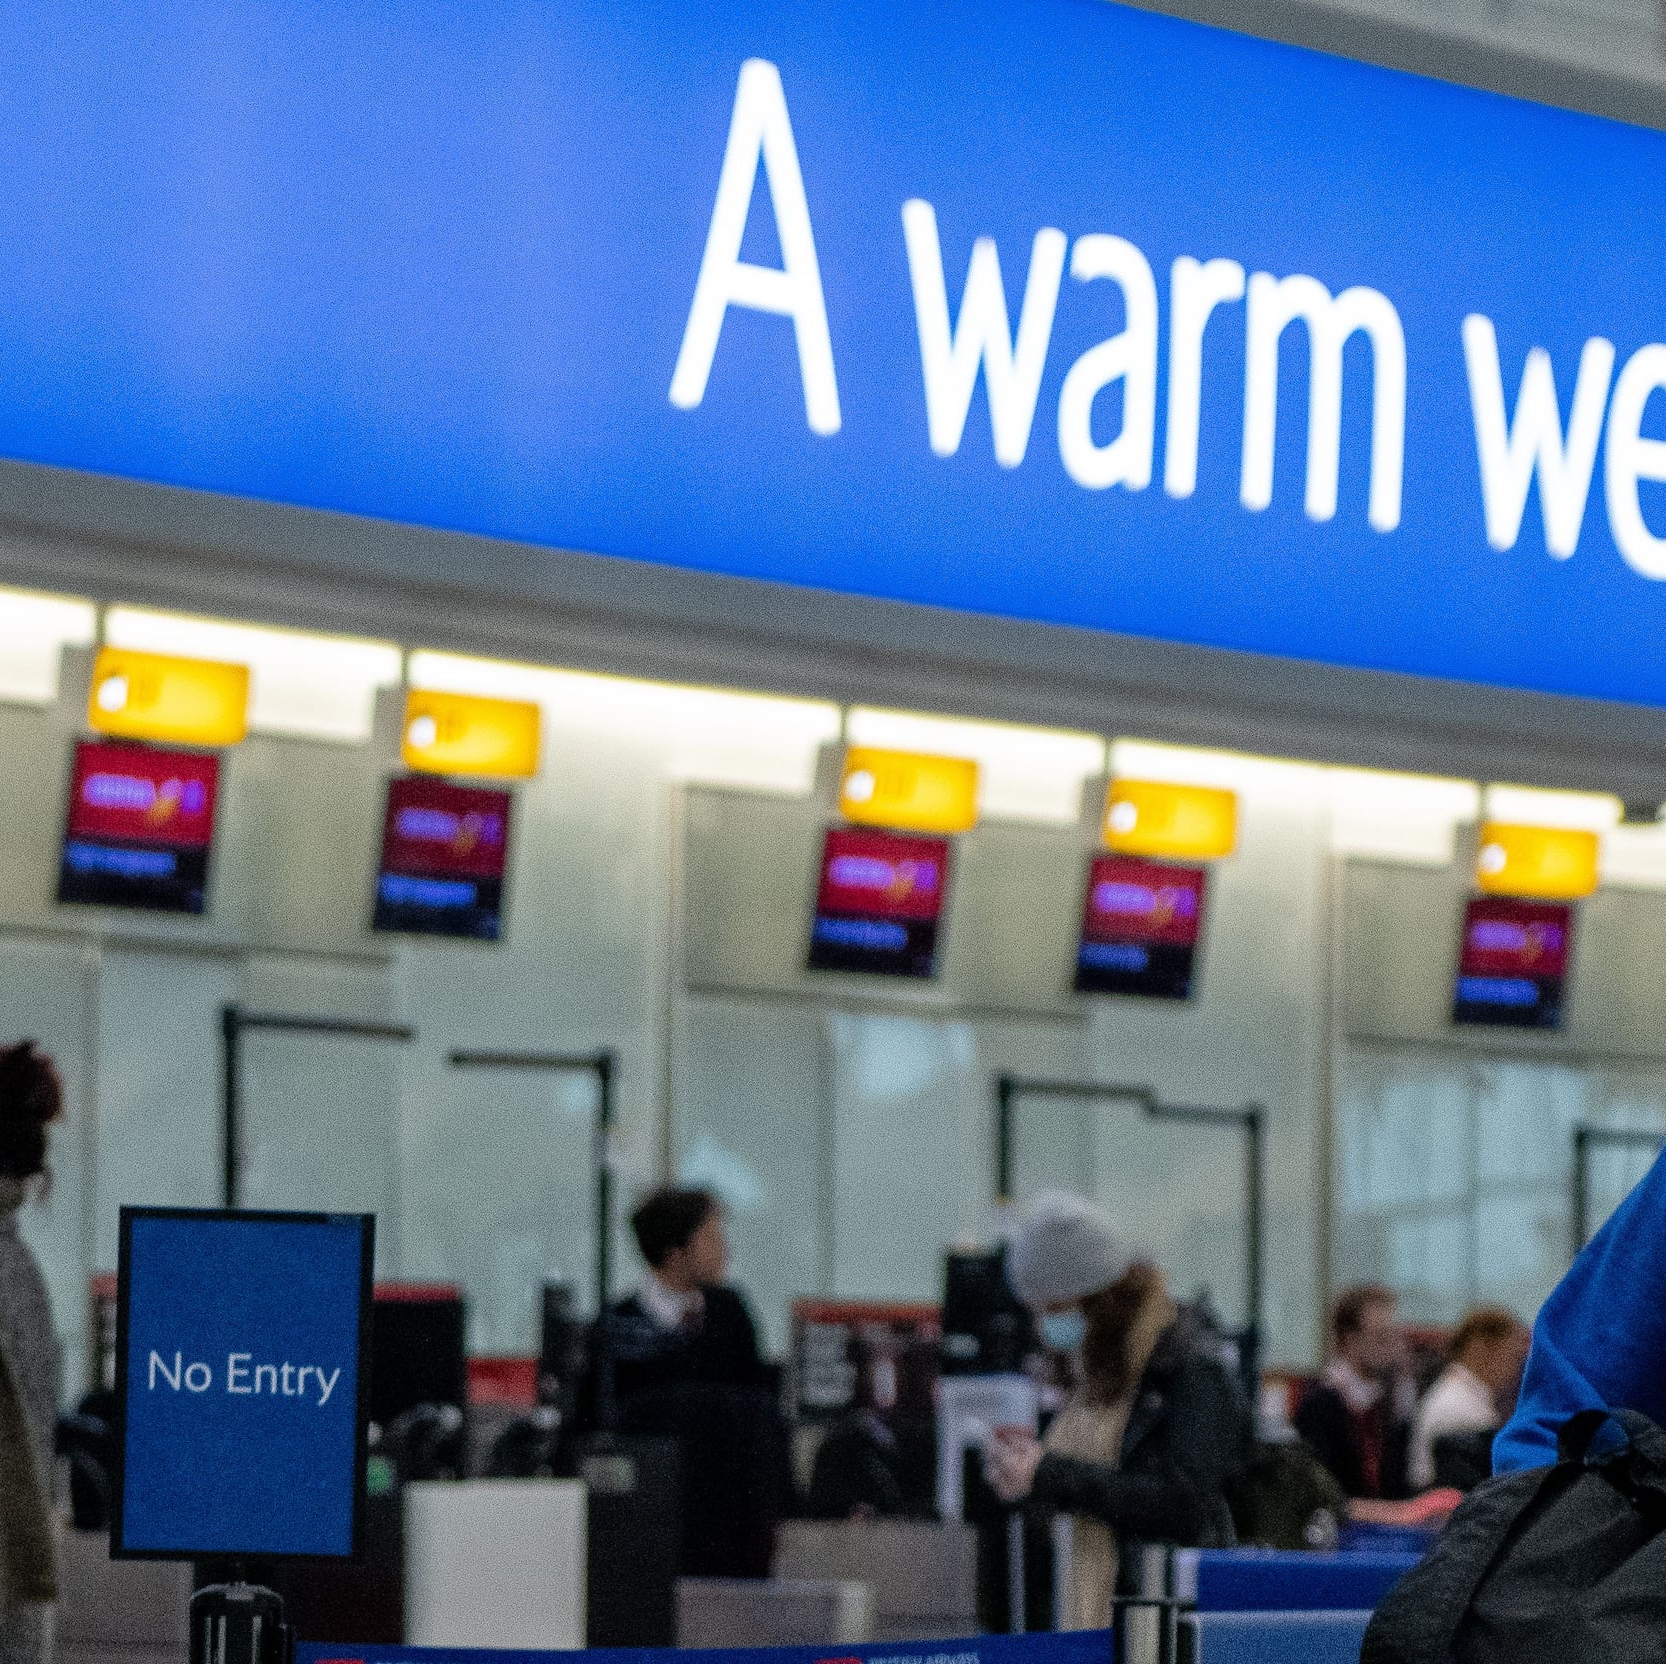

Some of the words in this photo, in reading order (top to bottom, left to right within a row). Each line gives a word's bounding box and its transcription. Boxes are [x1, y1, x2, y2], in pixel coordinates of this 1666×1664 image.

[668, 57, 843, 437] A
[900, 197, 1408, 533] warm
[148, 1350, 212, 1393] No
[227, 1352, 341, 1406] Entry
